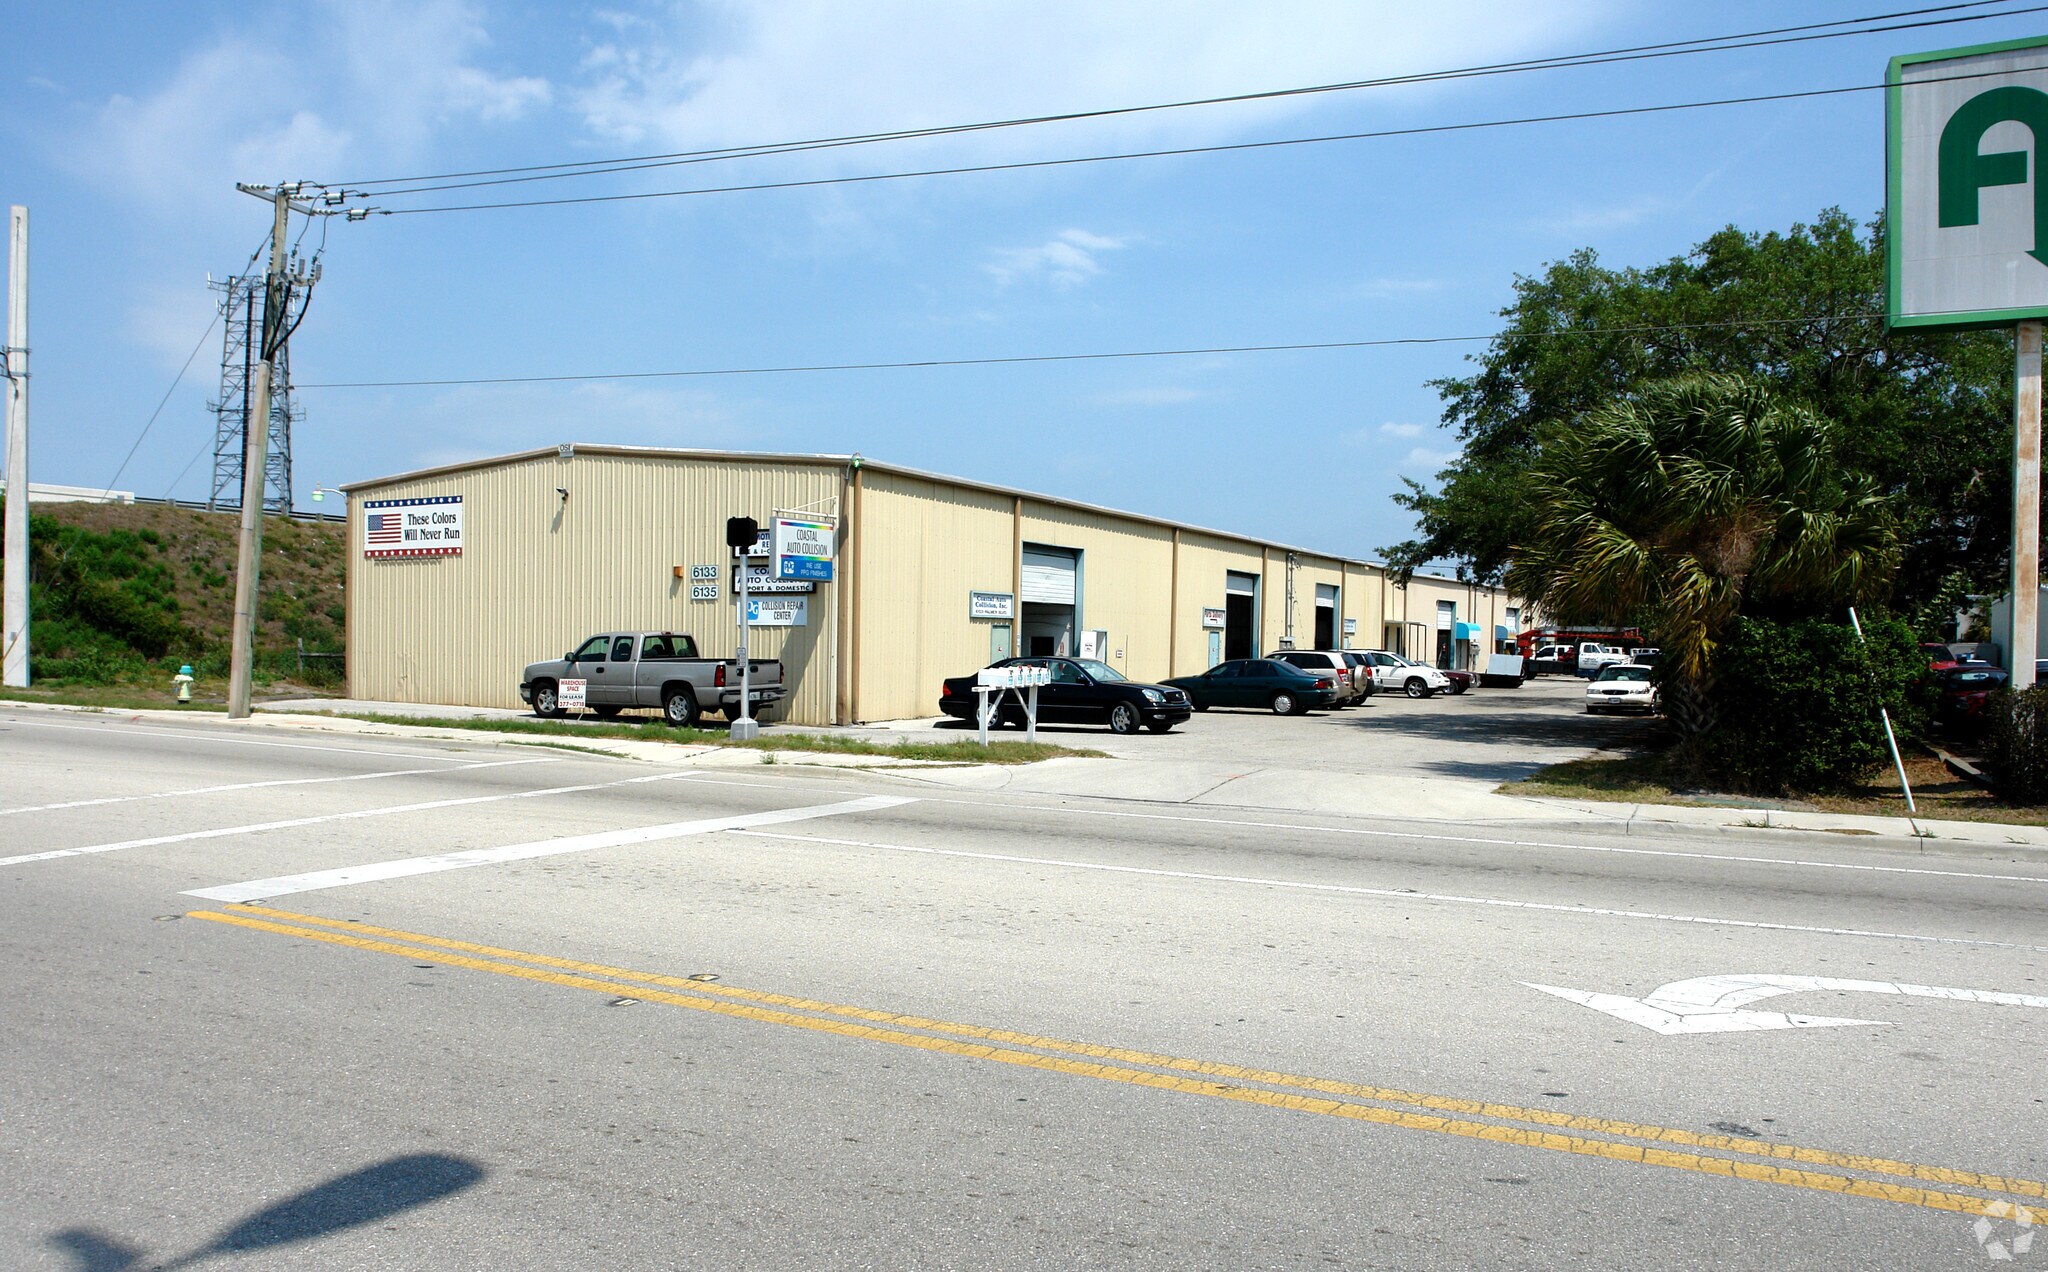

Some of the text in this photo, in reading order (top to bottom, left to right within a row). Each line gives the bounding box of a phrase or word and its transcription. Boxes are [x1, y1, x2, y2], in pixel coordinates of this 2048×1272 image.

[407, 512, 457, 525] These Colors
[404, 527, 460, 540] Will Never Run
[796, 529, 818, 542] COASTAL
[787, 542, 828, 556] AUTO COLLISION
[693, 566, 717, 578] 6133
[693, 586, 717, 598] 6135
[762, 601, 804, 611] COLLISION REPAIR
[773, 611, 792, 620] CENTER
